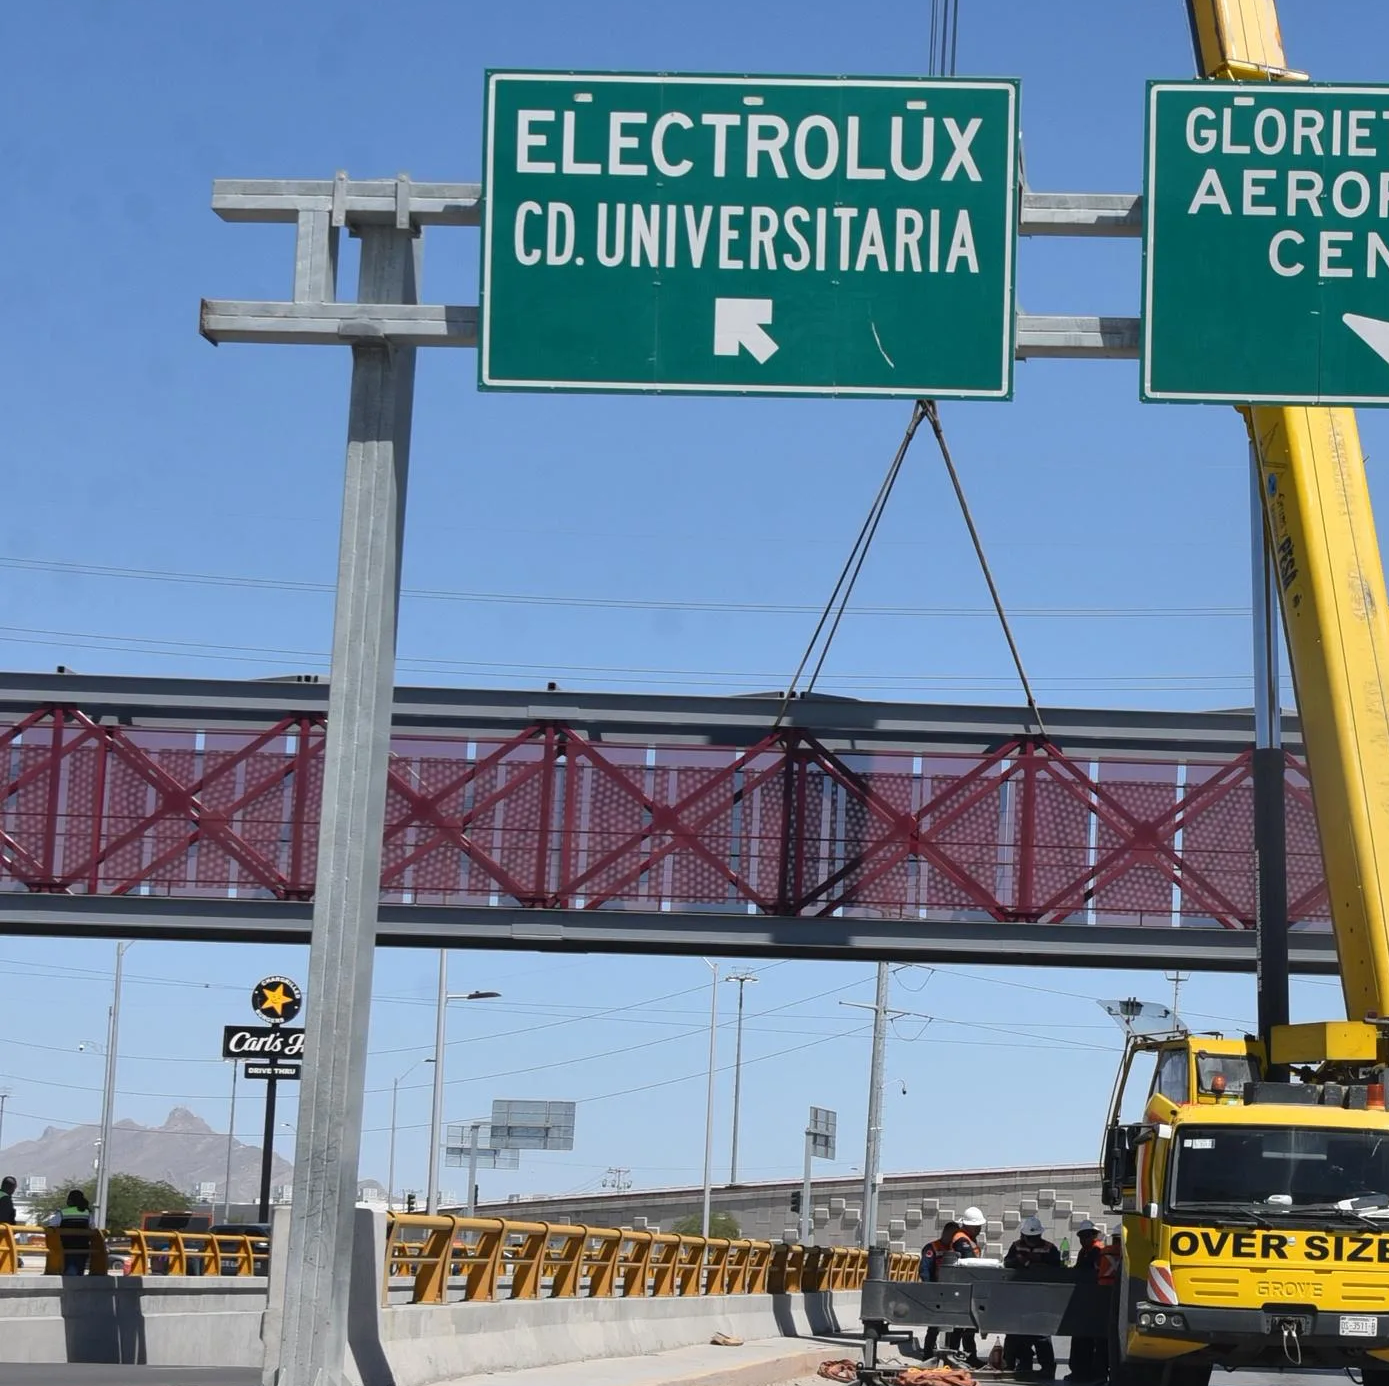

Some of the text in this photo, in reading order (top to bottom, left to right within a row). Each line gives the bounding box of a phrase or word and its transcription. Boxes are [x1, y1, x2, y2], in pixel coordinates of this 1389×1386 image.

[516, 109, 983, 181] ELECTROLUX
[514, 201, 980, 273] CD. UNIVERSITARIA
[229, 1032, 284, 1052] Carl's
[1170, 1231, 1289, 1260] OVER
[1257, 1281, 1324, 1298] GROVE
